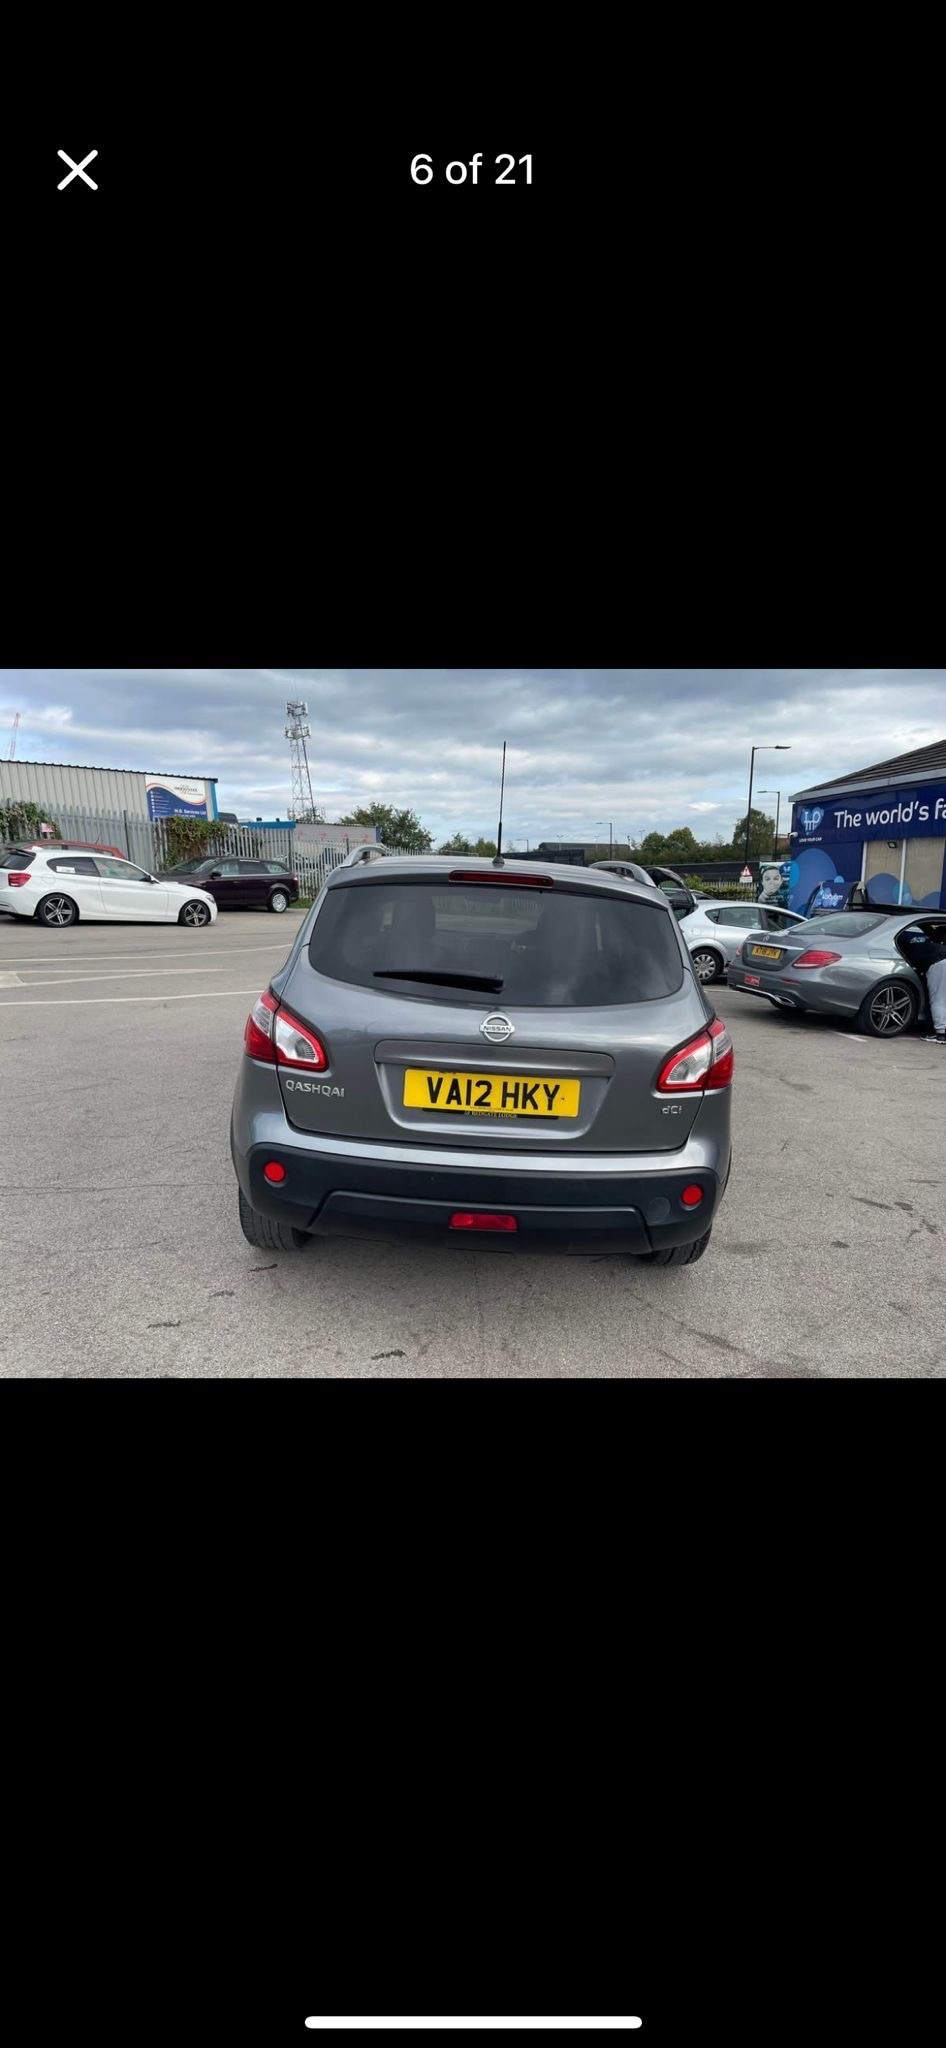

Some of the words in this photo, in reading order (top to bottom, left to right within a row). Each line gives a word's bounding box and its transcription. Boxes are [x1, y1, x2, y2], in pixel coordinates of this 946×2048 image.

[834, 809, 861, 828] The
[866, 800, 930, 826] world's
[285, 1079, 345, 1097] QASHQAI
[426, 1076, 493, 1108] VA12
[500, 1081, 561, 1111] HKY
